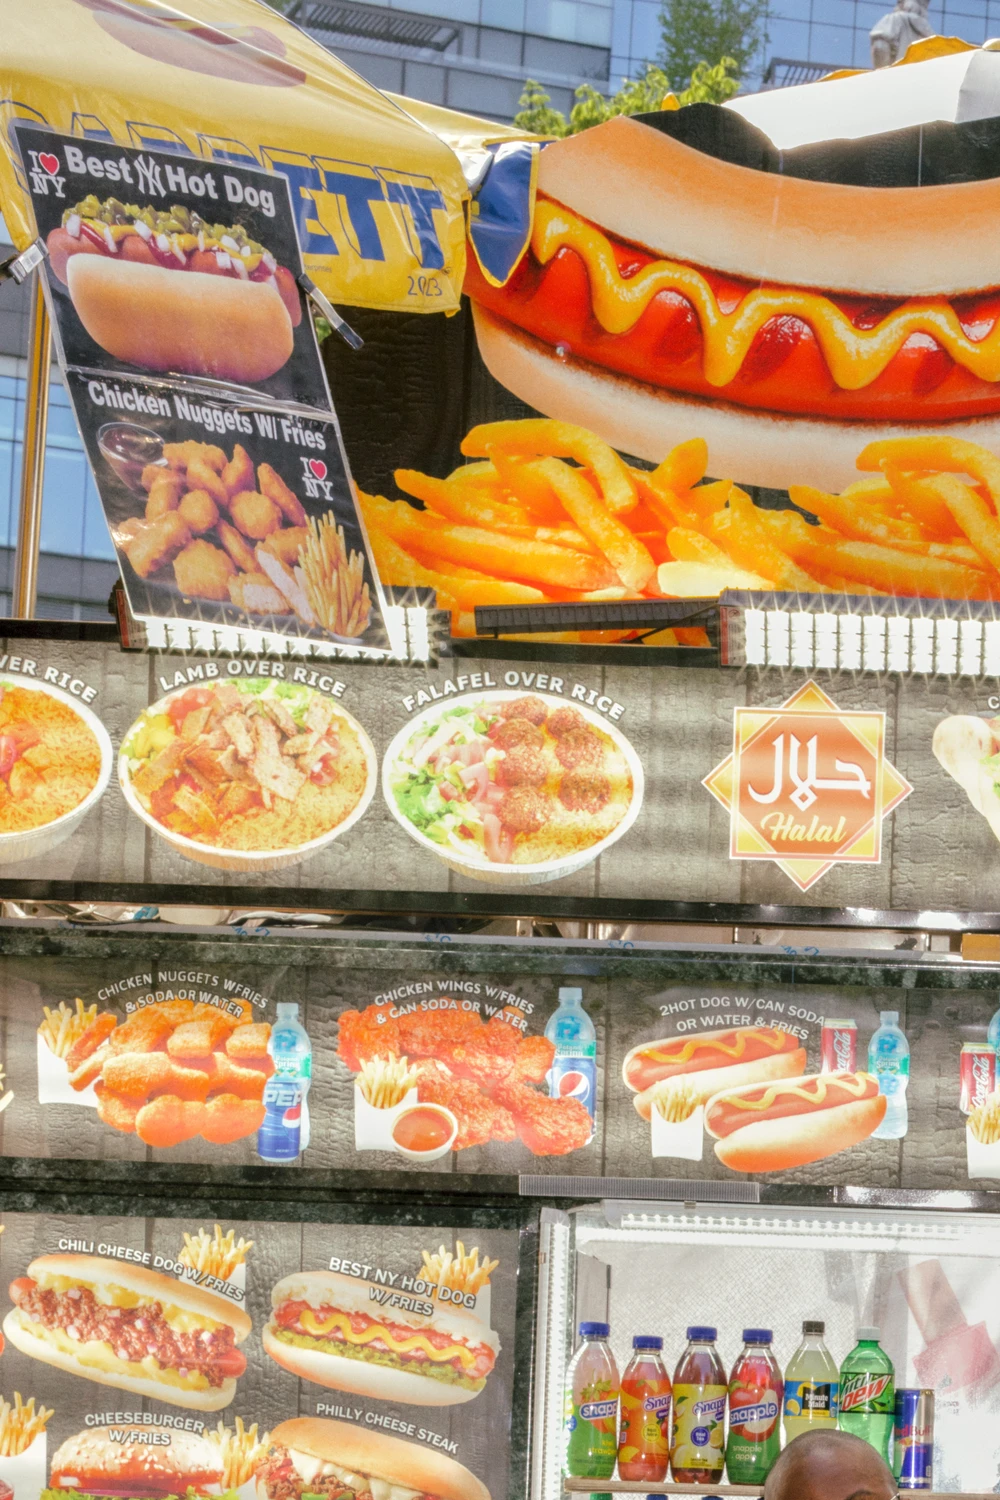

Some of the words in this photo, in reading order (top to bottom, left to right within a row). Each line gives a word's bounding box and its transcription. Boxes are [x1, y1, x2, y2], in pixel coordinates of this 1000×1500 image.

[32, 174, 66, 198] NY
[64, 145, 134, 185] Best
[165, 163, 219, 200] Hot
[226, 175, 275, 217] Dog
[88, 380, 171, 418] Chicken
[174, 395, 254, 436] Nuggets
[283, 419, 327, 451] Fries
[302, 475, 334, 501] NY
[44, 665, 98, 704] RICE
[158, 660, 220, 692] LAMB
[226, 659, 285, 678] OVER
[292, 665, 347, 699] RICE
[401, 671, 497, 713] FALAFEL
[504, 671, 568, 698] OVER
[570, 684, 627, 722] RICE
[746, 732, 872, 812] حلال
[760, 812, 847, 844] Halal
[97, 973, 153, 1001] CHICKEN
[158, 970, 220, 988] NUGGETS
[137, 988, 175, 1009] SODA
[199, 990, 245, 1018] WATER
[374, 980, 433, 1008] CHICKEN
[436, 980, 482, 995] WINGS
[388, 1003, 418, 1022] CAN
[422, 998, 460, 1012] SODA
[484, 1004, 529, 1034] WATER
[675, 1018, 698, 1033] OR
[700, 1013, 751, 1028] WATER
[769, 1018, 810, 1042] FRIES
[700, 996, 732, 1009] DOG
[787, 1003, 826, 1028] SODA
[58, 1238, 94, 1254] CHILI
[97, 1242, 151, 1265] CHEESE
[153, 1255, 184, 1276] DOG
[328, 1256, 372, 1280] BEST
[374, 1268, 400, 1287] NY
[401, 1278, 435, 1298] HOT
[437, 1285, 477, 1309] DOG
[84, 1411, 205, 1434] CHEESEBURGER
[316, 1403, 363, 1421] PHILLY
[364, 1411, 416, 1437] CHEESE
[417, 1427, 459, 1455] STEAK
